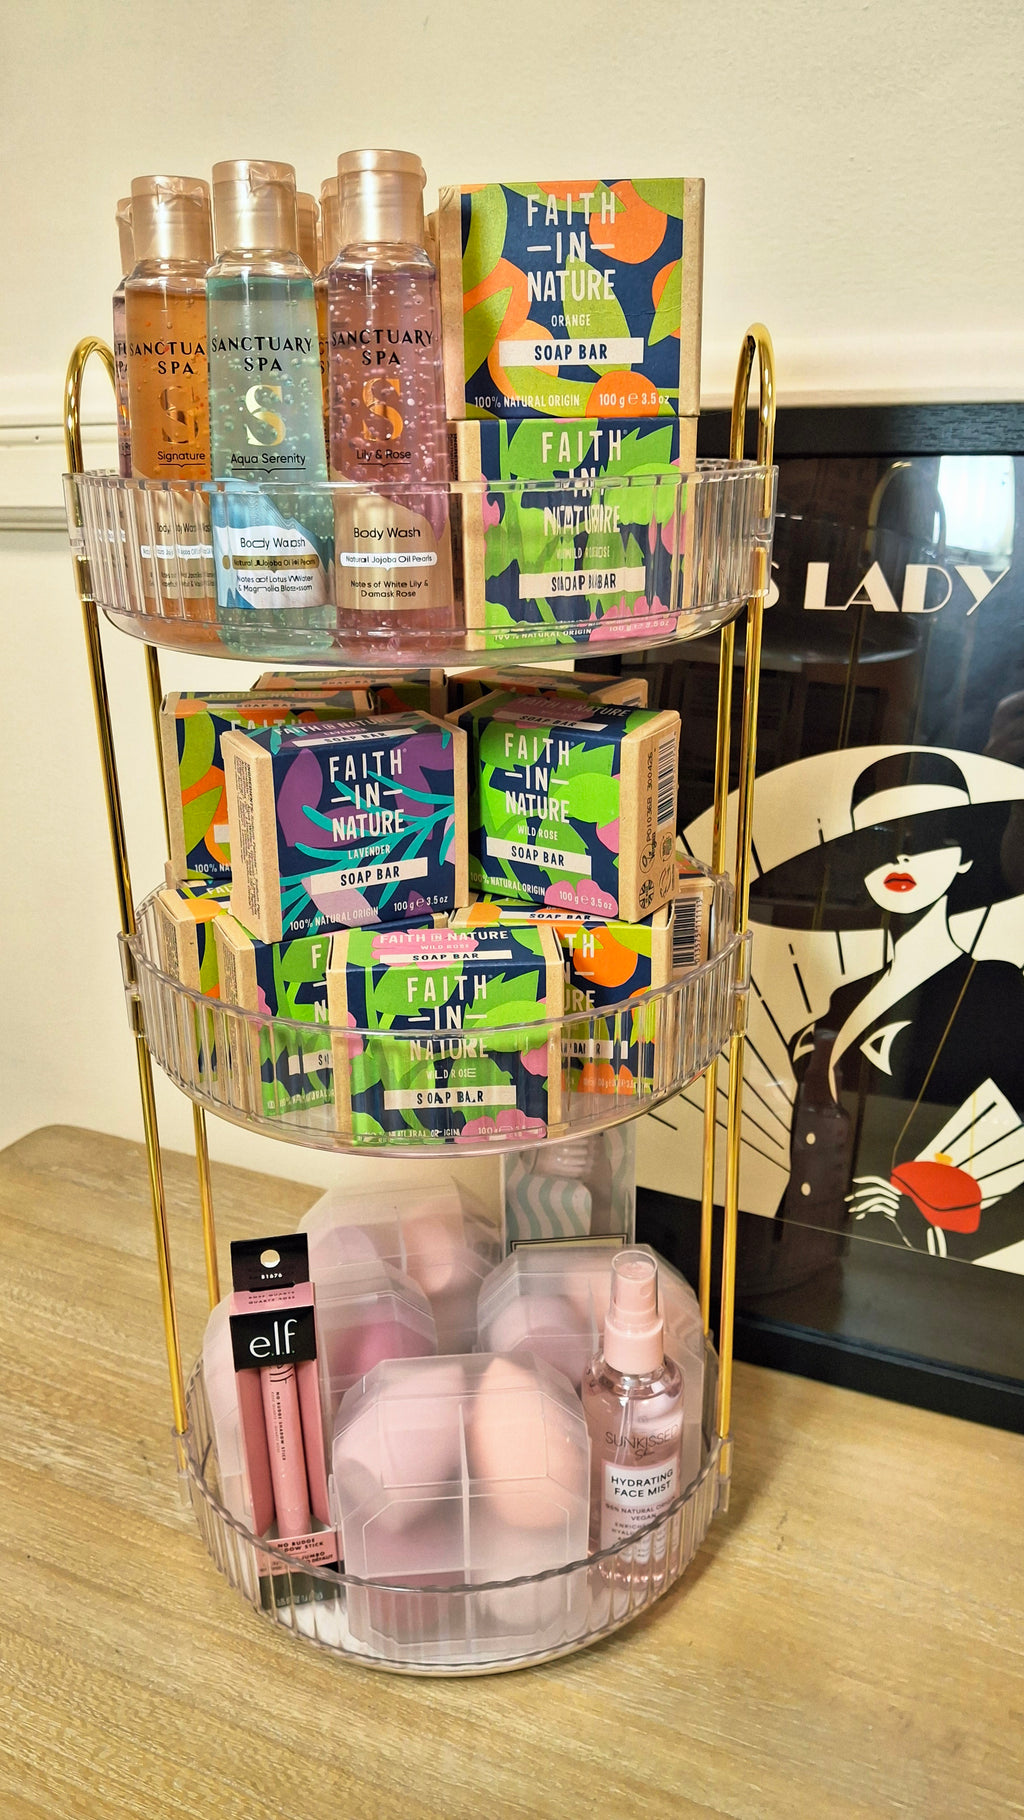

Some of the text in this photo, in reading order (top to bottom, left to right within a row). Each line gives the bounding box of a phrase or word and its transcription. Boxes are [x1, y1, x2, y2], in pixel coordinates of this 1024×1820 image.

[527, 191, 616, 227] FAITH
[556, 231, 586, 263] IN
[527, 269, 616, 302] NATURE
[551, 314, 591, 327] ORANGE
[211, 336, 312, 354] SANCTUARY
[332, 329, 433, 347] SANCTUARY
[129, 341, 205, 357] SANCTUA
[534, 343, 608, 360] SOAP BAR
[244, 357, 283, 372] SPA
[361, 351, 400, 366] SPA
[157, 361, 194, 375] SPA
[474, 393, 669, 408] 100% NATURAL ORIGIN 100 g 3.5 oz
[245, 384, 286, 447] S
[541, 430, 622, 463] FAITH
[157, 450, 206, 463] Signature
[231, 453, 306, 466] Aqua Serenity
[357, 450, 411, 462] Lily & Rose
[353, 527, 421, 541] Body Wash
[345, 554, 432, 565] Natural Jojoba Oil Pearls
[350, 580, 372, 588] Notes
[373, 580, 382, 588] of
[383, 580, 408, 588] White
[409, 579, 422, 588] Lily
[803, 561, 1011, 616] LADY
[361, 589, 417, 598] Damask Rose
[520, 715, 551, 724] SOAP
[273, 723, 320, 736] FAITH
[324, 731, 387, 745] SOAP BAR
[504, 732, 570, 766] FAITH
[329, 749, 403, 783] FAITH
[525, 764, 549, 792] IN
[355, 781, 380, 810] IN
[505, 790, 571, 825] NATURE
[331, 808, 406, 843] NATURE
[517, 824, 558, 841] WILD ROSE
[348, 844, 391, 860] LAVENDER
[511, 844, 565, 867] SOAP BAR
[340, 866, 401, 888] SOAP BAR
[490, 876, 522, 892] NATURAL
[522, 881, 545, 897] ORIGIN
[559, 890, 573, 903] 100
[574, 894, 580, 905] g
[590, 896, 602, 908] 3.5
[603, 900, 613, 910] oz
[290, 895, 449, 932] 100% NATURAL ORIGIN 100 g 3.5 oz
[380, 933, 426, 944] FAITH
[448, 930, 510, 941] NATURE
[420, 943, 445, 951] WILD
[412, 952, 479, 962] SOAP BAR
[407, 974, 488, 1003] FAITH
[434, 1005, 462, 1031] IN
[410, 1038, 489, 1062] NATURE
[416, 1089, 485, 1105] SOAP BAR
[605, 1424, 679, 1449] SUNKISSED
[611, 1468, 673, 1488] HYDRATING
[614, 1480, 672, 1498] FACE MIST
